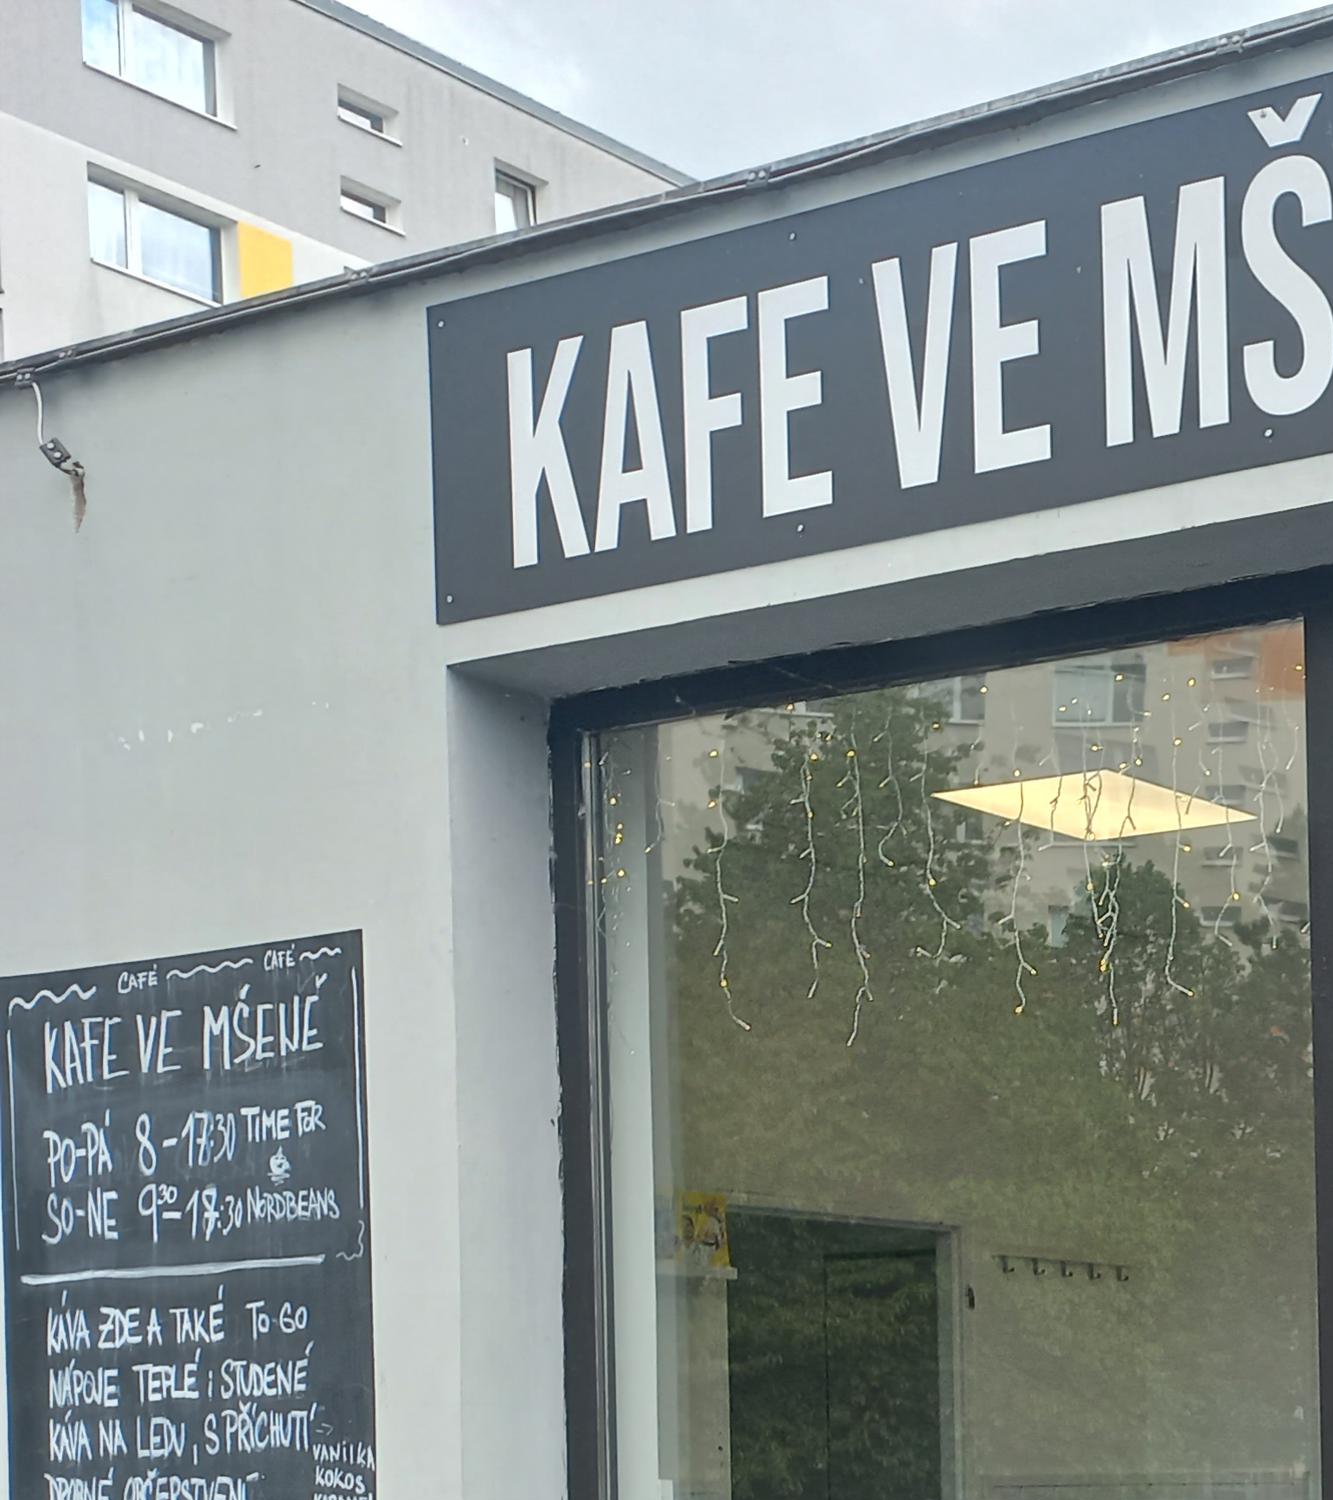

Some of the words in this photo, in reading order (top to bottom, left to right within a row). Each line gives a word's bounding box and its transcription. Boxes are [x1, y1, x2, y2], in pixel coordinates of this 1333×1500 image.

[507, 275, 835, 569] KAFE
[872, 221, 1052, 490] VE
[118, 964, 158, 994] CAFÉ
[264, 944, 296, 970] CAFÉ
[44, 1014, 130, 1094] KAFE
[136, 1009, 182, 1074] VE
[42, 1108, 113, 1188] PO-PÁ
[41, 1186, 119, 1246] SO-NE
[47, 1289, 91, 1356] KÁVA
[98, 1306, 143, 1349] ZDE
[146, 1307, 163, 1346] A
[169, 1284, 225, 1345] TAKÉ
[50, 1358, 120, 1409] NÁPOJE
[132, 1348, 201, 1406] TEPLÉ
[220, 1340, 315, 1400] STUDENÉ
[49, 1409, 93, 1462] KÁVA
[99, 1418, 128, 1461] NA
[204, 1412, 220, 1456] S
[315, 1465, 367, 1495] KOKOS
